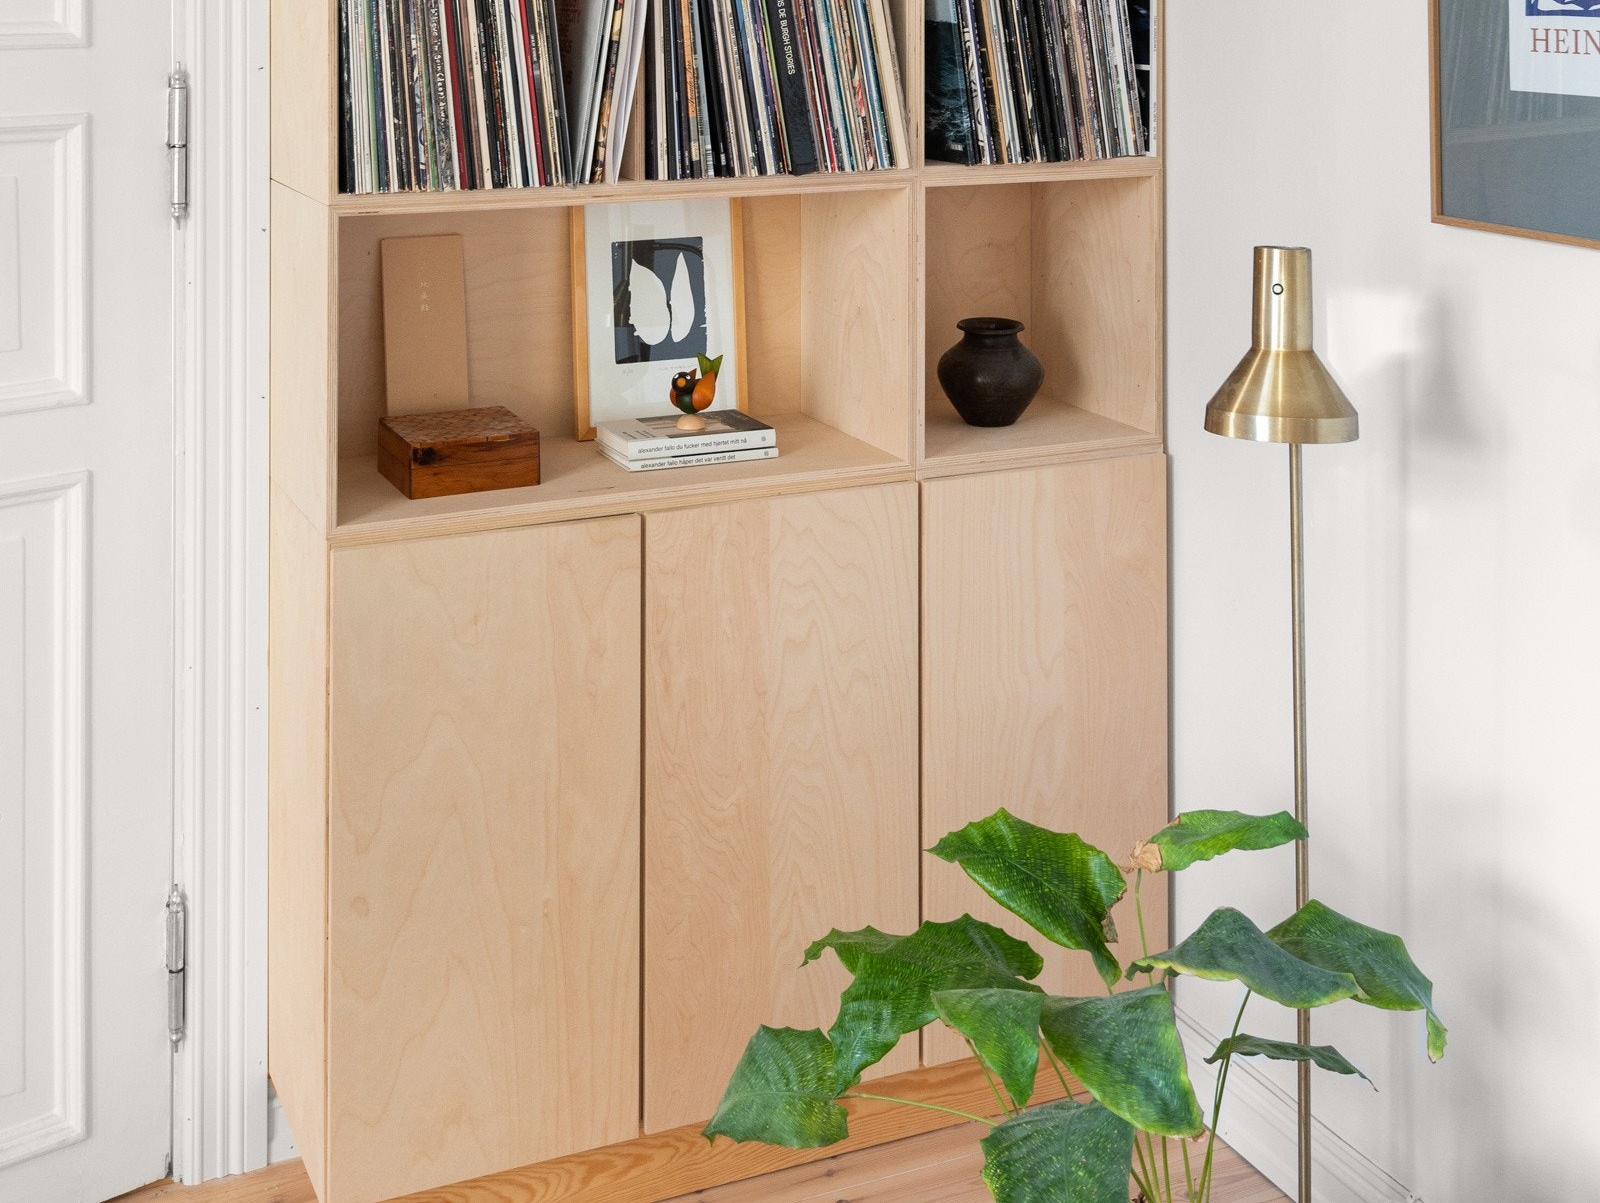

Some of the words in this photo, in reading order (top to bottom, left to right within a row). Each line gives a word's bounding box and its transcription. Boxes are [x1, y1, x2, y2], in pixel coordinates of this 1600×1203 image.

[778, 9, 786, 18] DE
[780, 20, 790, 44] BURGH
[1530, 28, 1600, 55] HEIN
[784, 46, 795, 74] STORIES
